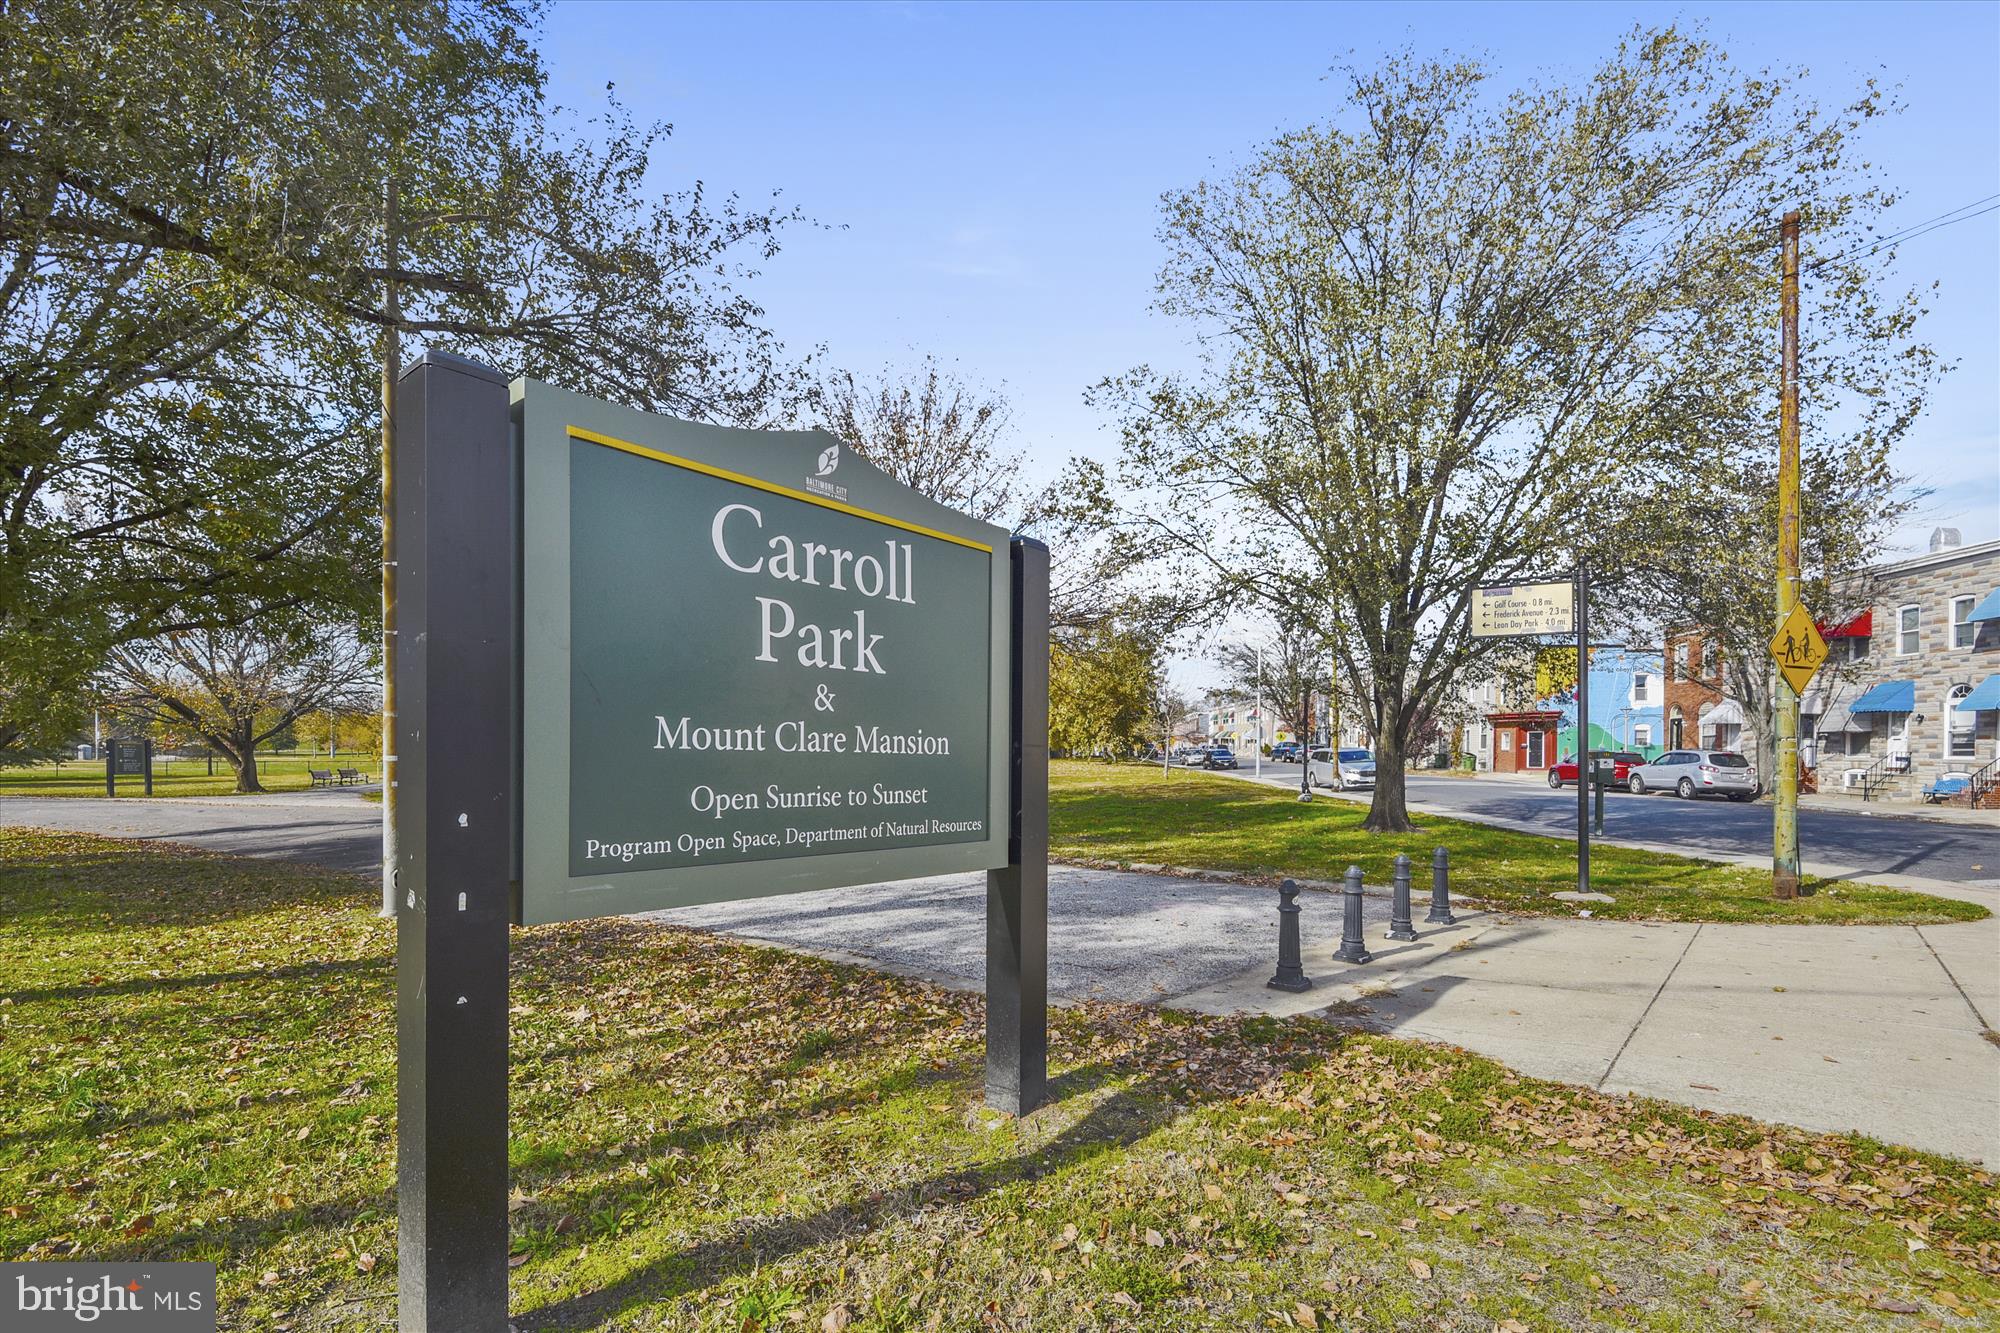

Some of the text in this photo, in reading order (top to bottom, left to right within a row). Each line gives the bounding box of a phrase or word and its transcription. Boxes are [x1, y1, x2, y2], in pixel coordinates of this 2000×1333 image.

[806, 477, 848, 496] BALTIMORE CITY
[711, 503, 916, 605] Carroll
[1494, 600, 1506, 608] Golf
[1494, 609, 1520, 618] Frederick
[1549, 607, 1560, 615] 2.3
[754, 596, 887, 675] Park
[1510, 620, 1522, 629] Day
[814, 683, 836, 713] &
[653, 716, 951, 755] Mount Clare Mansion
[690, 783, 928, 820] Open Sunrise to Sunset
[586, 819, 982, 863] Program Open Space, Department of Natural Resources
